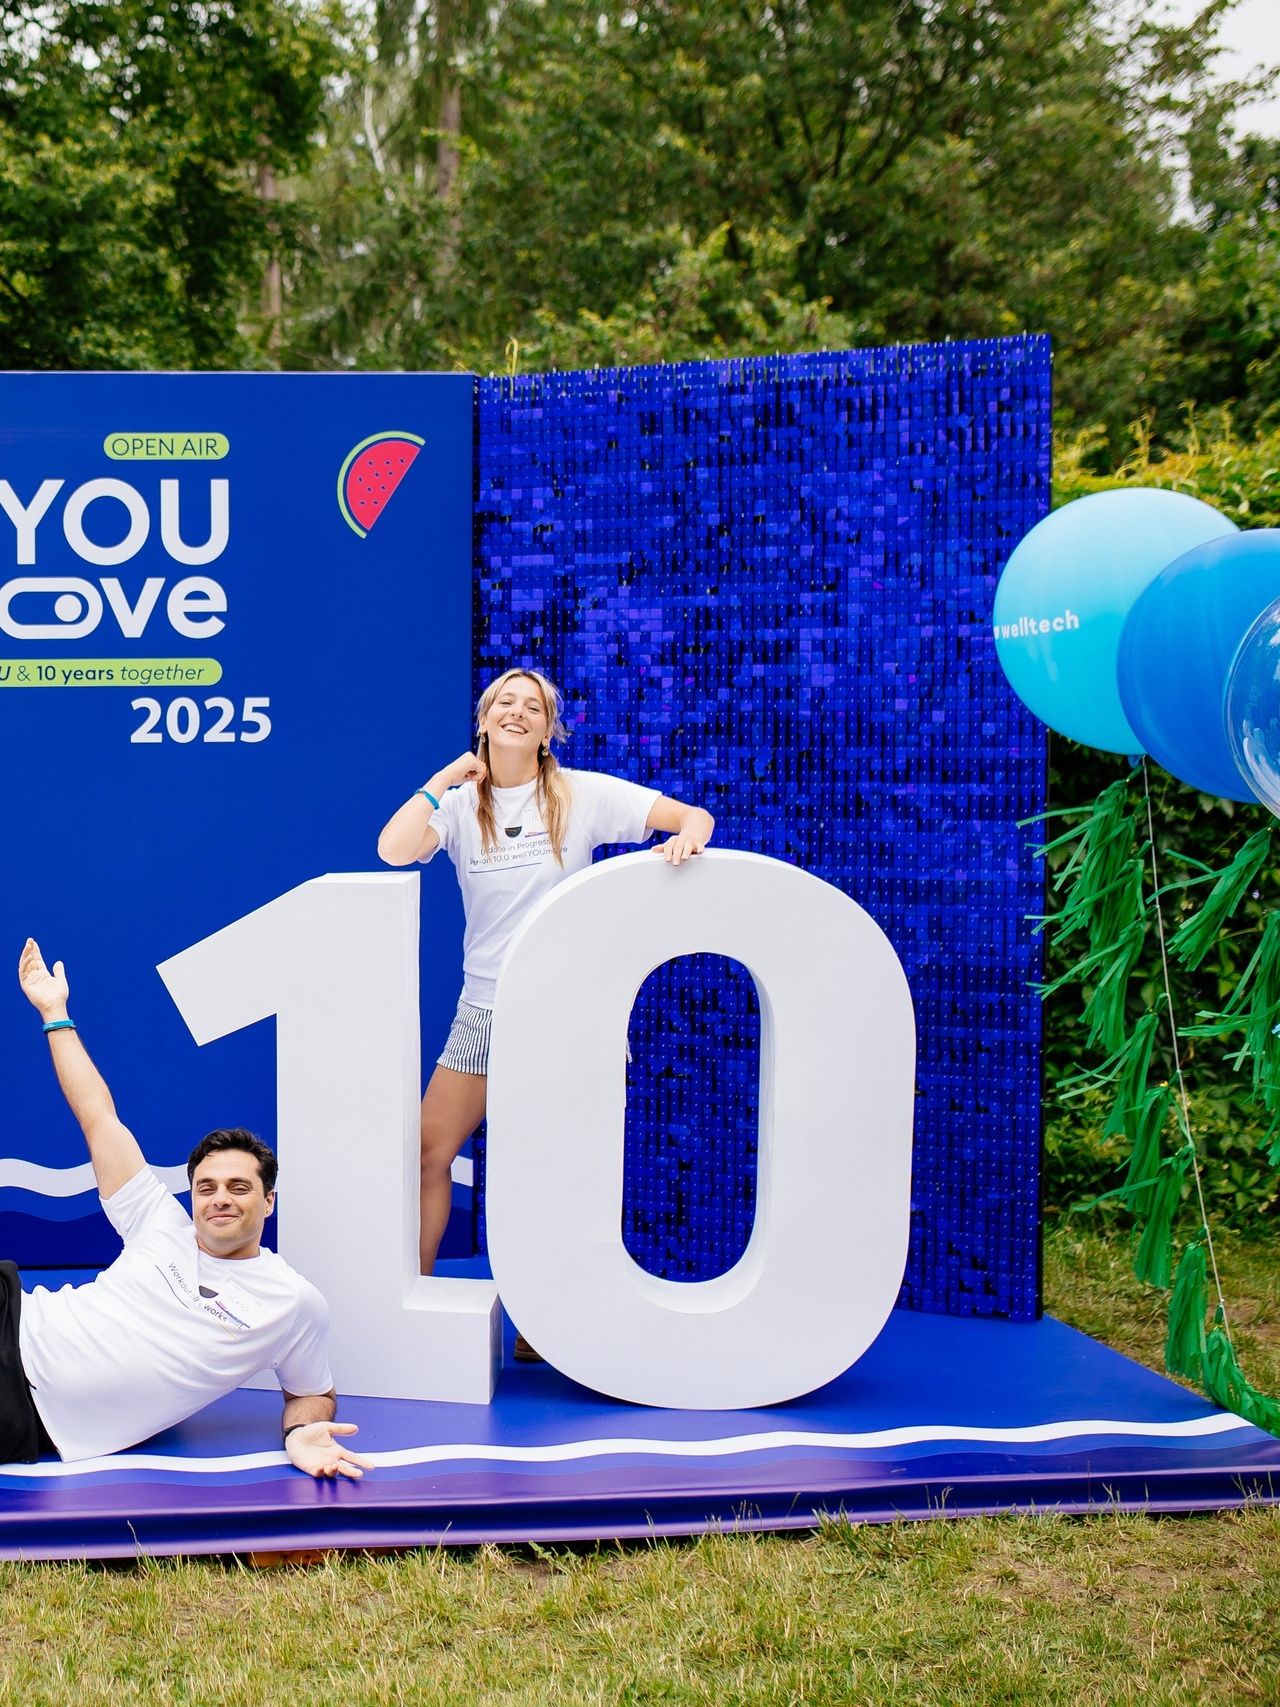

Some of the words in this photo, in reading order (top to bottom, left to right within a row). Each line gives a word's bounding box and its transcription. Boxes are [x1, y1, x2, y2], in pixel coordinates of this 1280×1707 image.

[111, 438, 174, 456] OPEN
[181, 438, 219, 456] AIR
[1001, 609, 1080, 639] welltech
[16, 665, 31, 681] &
[37, 665, 56, 681] 10
[61, 668, 114, 685] years
[120, 664, 205, 684] together
[130, 697, 272, 744] 2025
[156, 847, 916, 1411] 10
[168, 1262, 193, 1295] Workout
